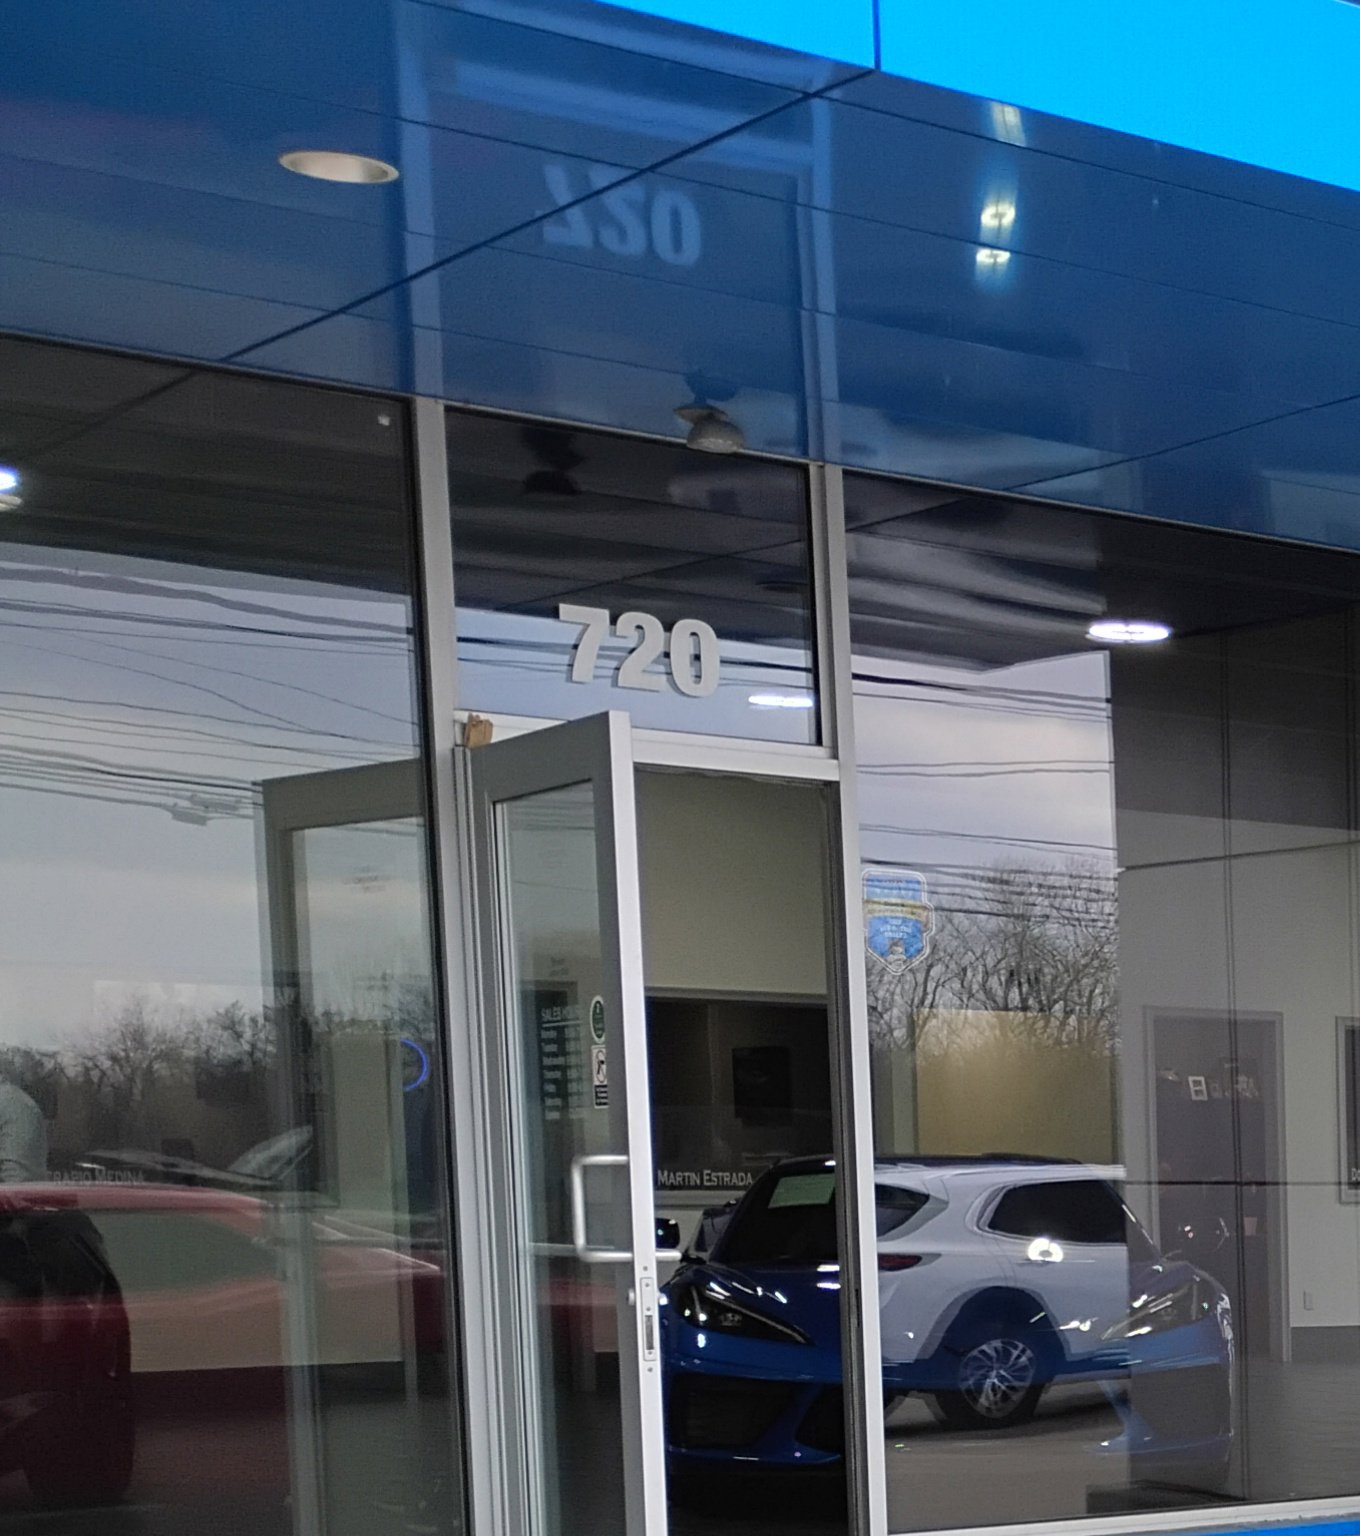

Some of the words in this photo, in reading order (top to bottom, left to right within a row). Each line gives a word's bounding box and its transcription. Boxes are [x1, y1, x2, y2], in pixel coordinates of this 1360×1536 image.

[558, 602, 721, 698] 720
[657, 1169, 701, 1187] MARTIN
[703, 1169, 754, 1187] ESTRADA
